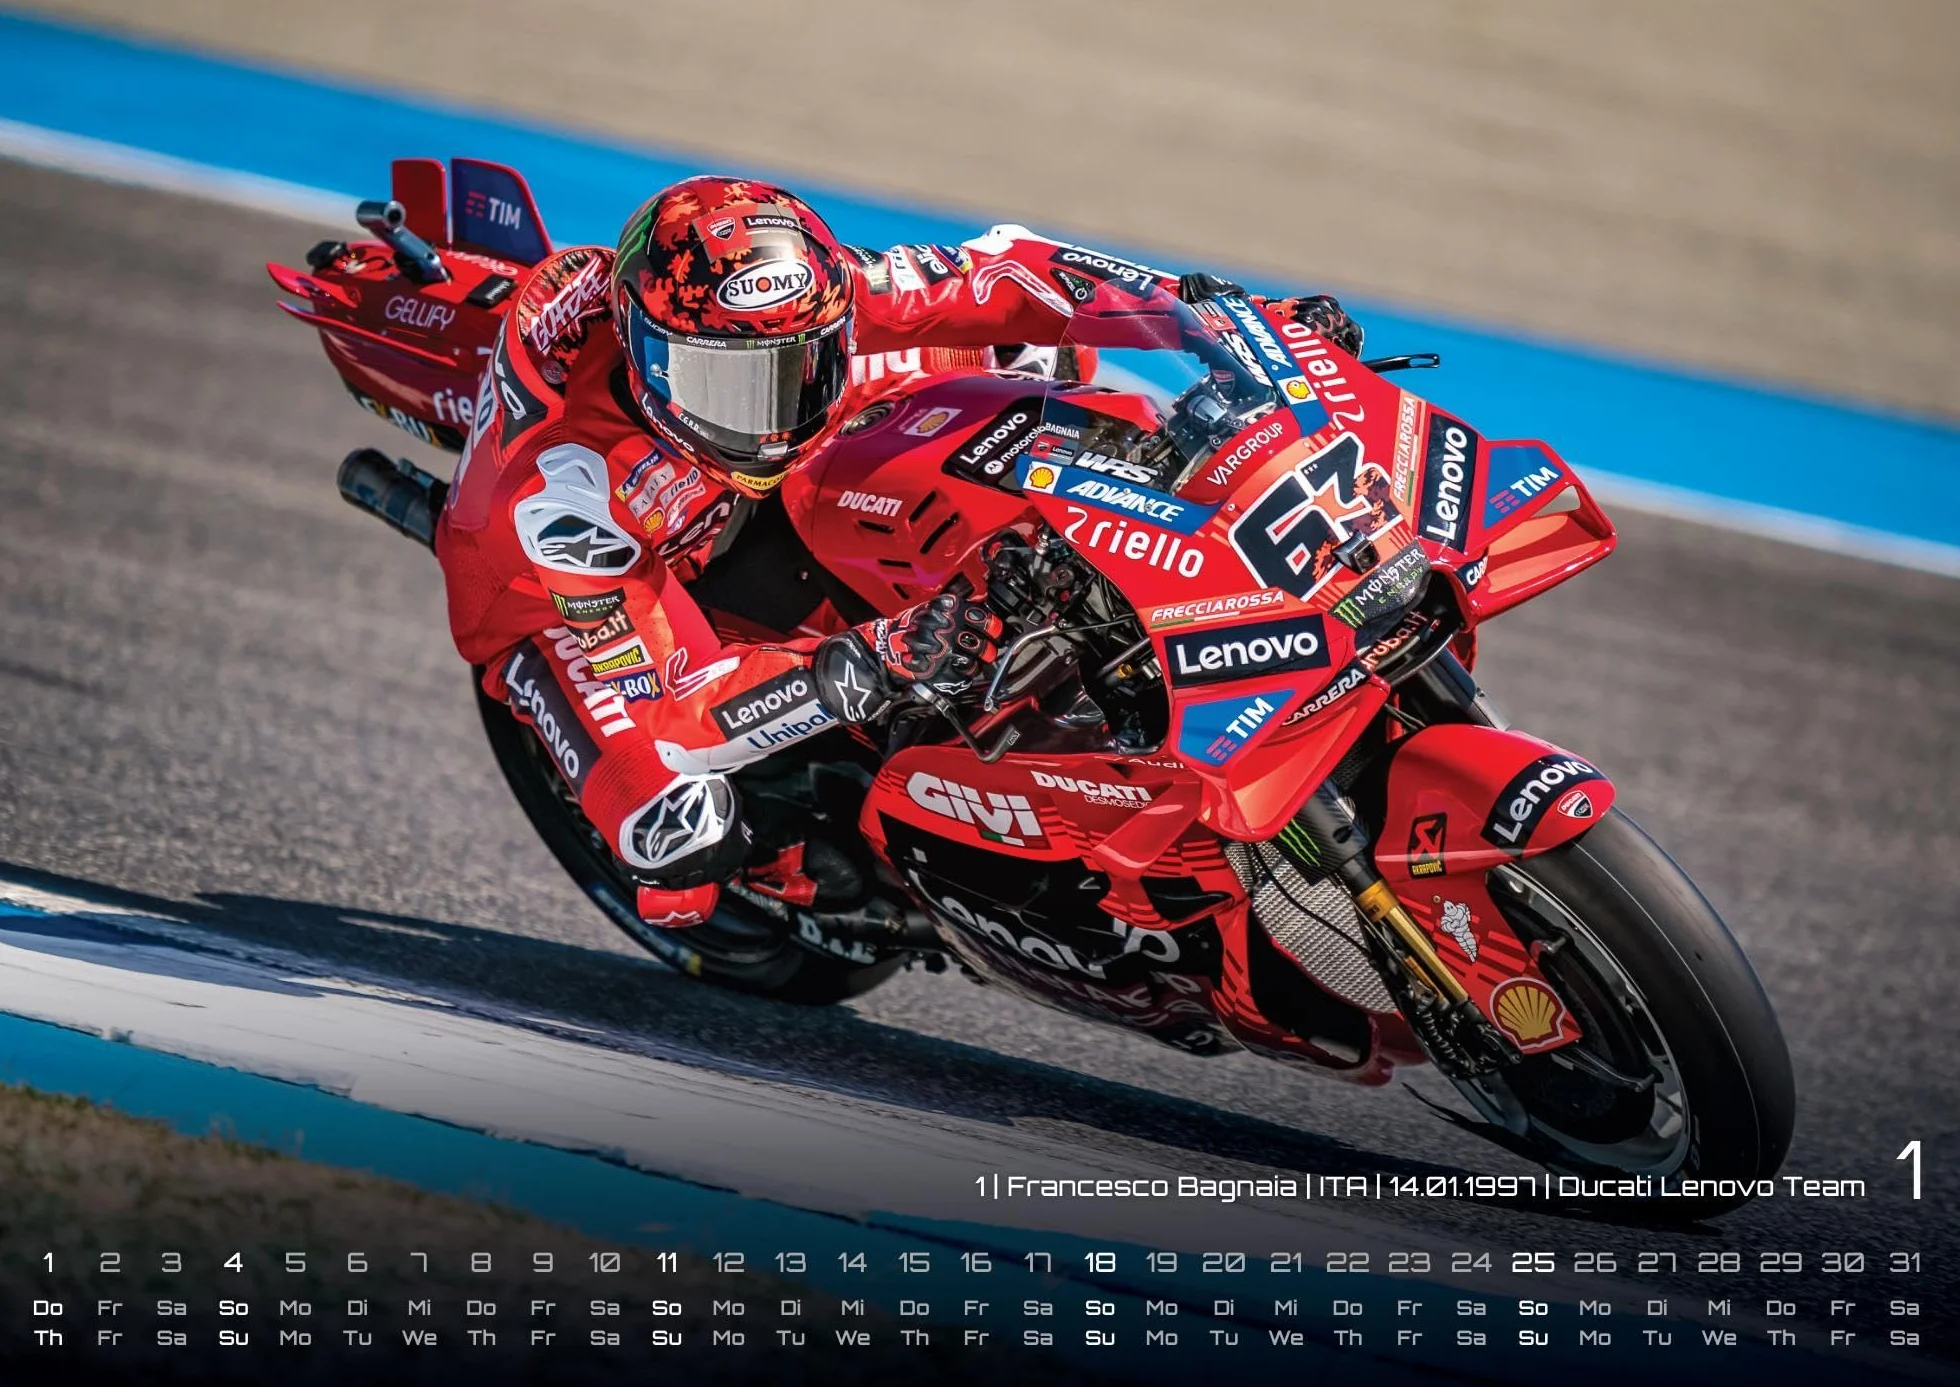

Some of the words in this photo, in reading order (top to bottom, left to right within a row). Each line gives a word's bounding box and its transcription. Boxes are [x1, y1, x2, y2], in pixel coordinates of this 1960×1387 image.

[488, 197, 522, 230] TIM
[747, 217, 795, 228] Lenovo
[727, 271, 808, 298] SUOMY
[1062, 252, 1154, 291] Lenovo
[385, 296, 456, 331] GELLIFY
[686, 336, 727, 348] CARRERA
[757, 336, 797, 347] MONSTER
[1282, 322, 1356, 403] riello
[641, 392, 695, 453] Lenovo
[959, 412, 1028, 465] Lenovo
[1045, 422, 1081, 440] BAGNAIA
[1001, 424, 1046, 463] motorola
[1206, 422, 1284, 486] VARGROUP
[1393, 396, 1418, 502] FRECCIAROSSA
[669, 469, 698, 497] riello
[1074, 451, 1159, 485] WRS
[1427, 427, 1468, 542] Lenovo
[1509, 466, 1559, 499] TIM
[837, 491, 903, 518] DUCATI
[1066, 480, 1185, 522] ADVANCE
[1228, 431, 1404, 603] 63
[1088, 520, 1205, 579] riello
[1354, 548, 1426, 606] MONSTER
[567, 595, 621, 610] MONSTER
[1150, 590, 1285, 622] FRECCIAROSSA
[1176, 630, 1319, 675] Lenovo
[721, 678, 809, 730] Lenovo
[1225, 697, 1275, 740] TIM
[1128, 758, 1185, 769] Audi
[906, 771, 1044, 838] GIVI
[1030, 770, 1154, 801] DUCATI
[1493, 760, 1595, 843] Lenovo
